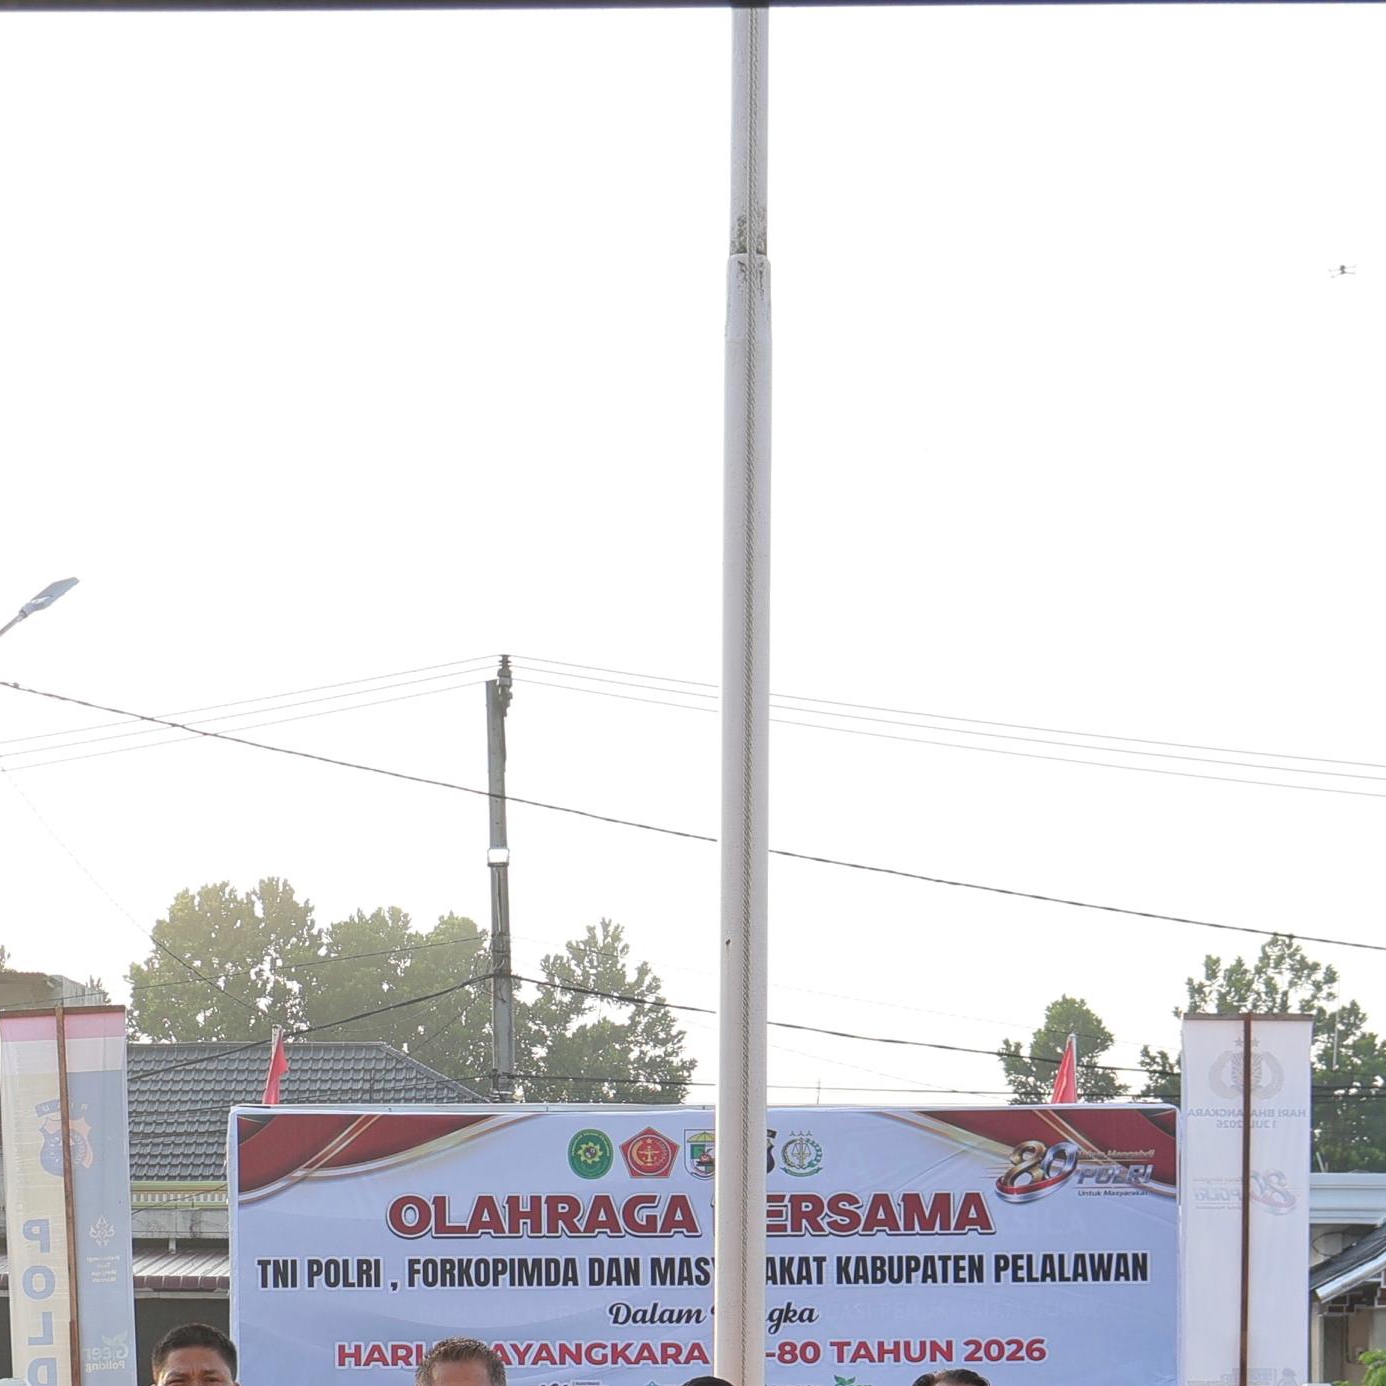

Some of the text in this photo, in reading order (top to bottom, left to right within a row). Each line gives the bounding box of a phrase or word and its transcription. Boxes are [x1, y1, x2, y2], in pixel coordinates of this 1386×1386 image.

[1076, 1164, 1154, 1185] POLRI
[388, 1192, 996, 1237] OLAHRAGA ERSAMA
[257, 1259, 298, 1288] TNI
[308, 1258, 381, 1289] POLRI
[408, 1257, 579, 1288] FORKOPIMDA
[588, 1257, 640, 1287] DAN
[651, 1255, 827, 1287] MASAKAT
[836, 1254, 984, 1285] KABUPATEN
[994, 1252, 1149, 1284] PELALAWAN
[608, 1302, 707, 1326] Dalam
[337, 1337, 1048, 1367] HARI AYANGKARA -80 TAHUN 2026
